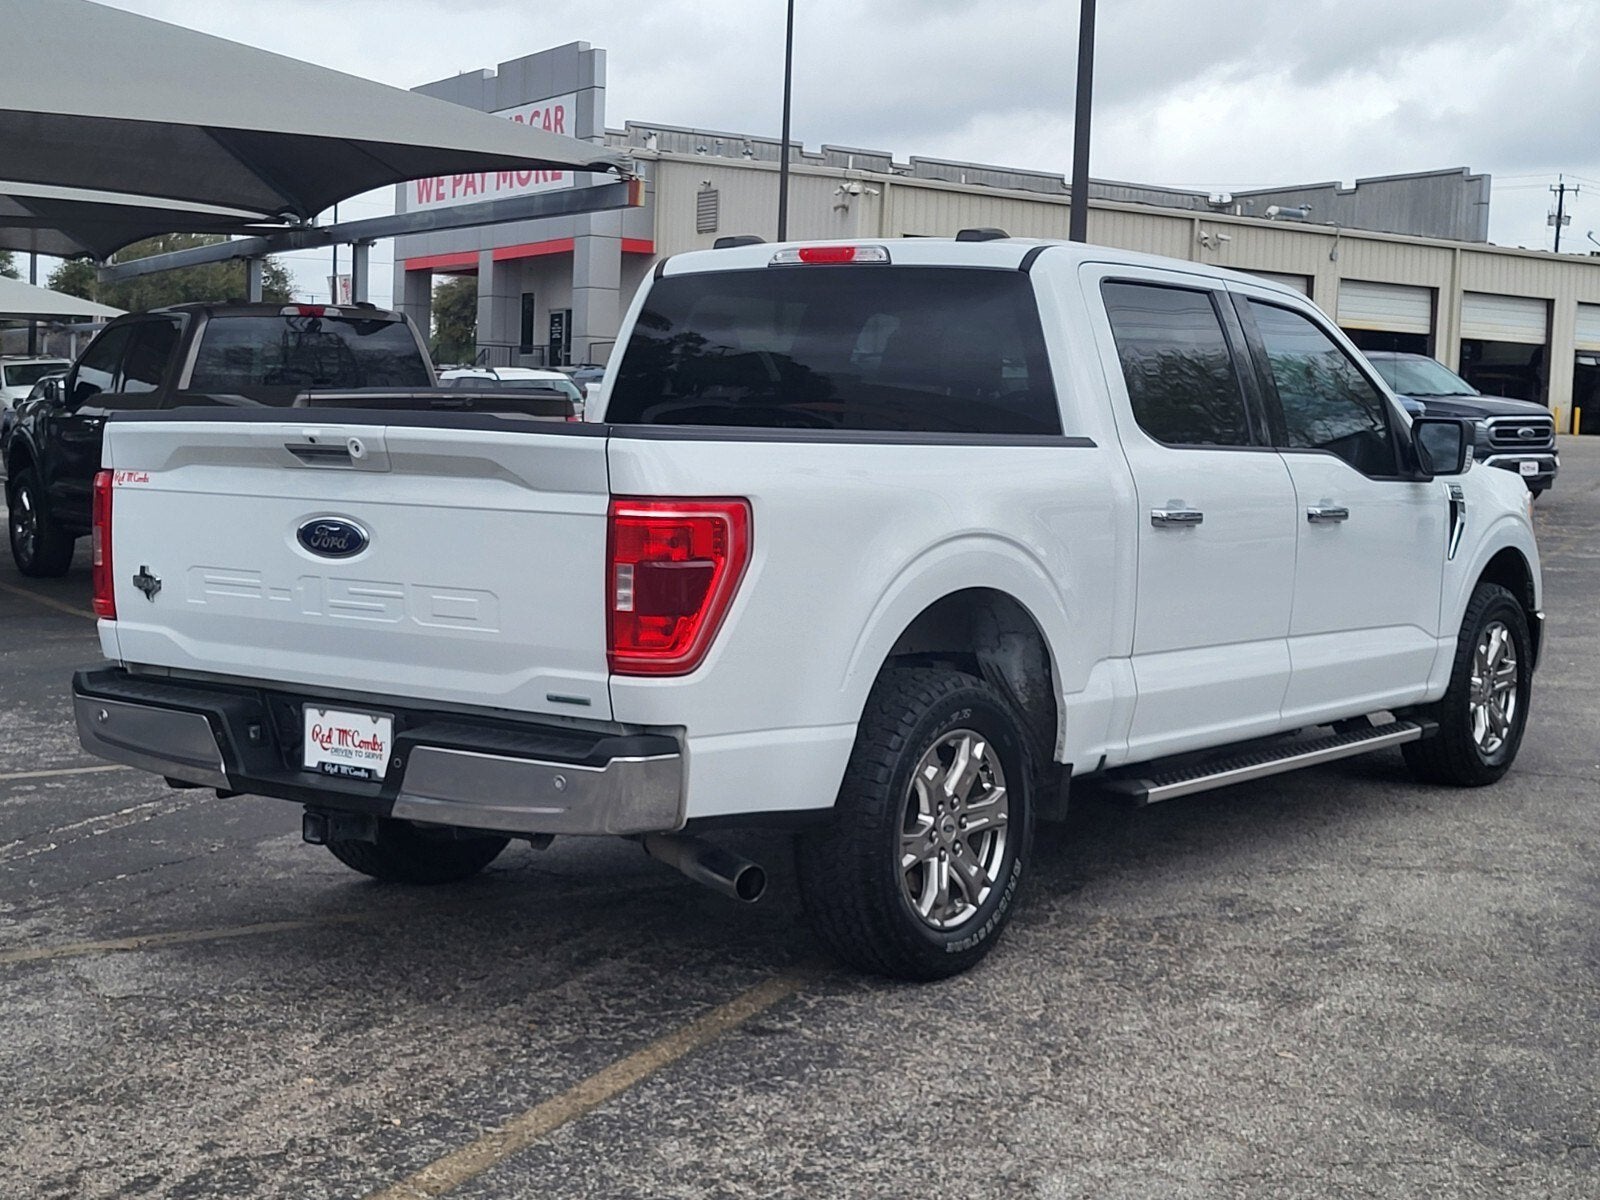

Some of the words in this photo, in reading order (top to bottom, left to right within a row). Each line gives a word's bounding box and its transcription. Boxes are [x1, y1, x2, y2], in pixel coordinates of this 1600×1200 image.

[530, 105, 564, 134] CAR
[417, 177, 446, 204] WE
[452, 172, 487, 198] PAY
[311, 524, 350, 549] Ford
[187, 565, 499, 633] F-150
[312, 724, 333, 751] Red
[335, 727, 384, 752] McCombs
[330, 747, 353, 759] DRIVEN
[354, 750, 363, 758] TO
[364, 751, 384, 760] SERVE
